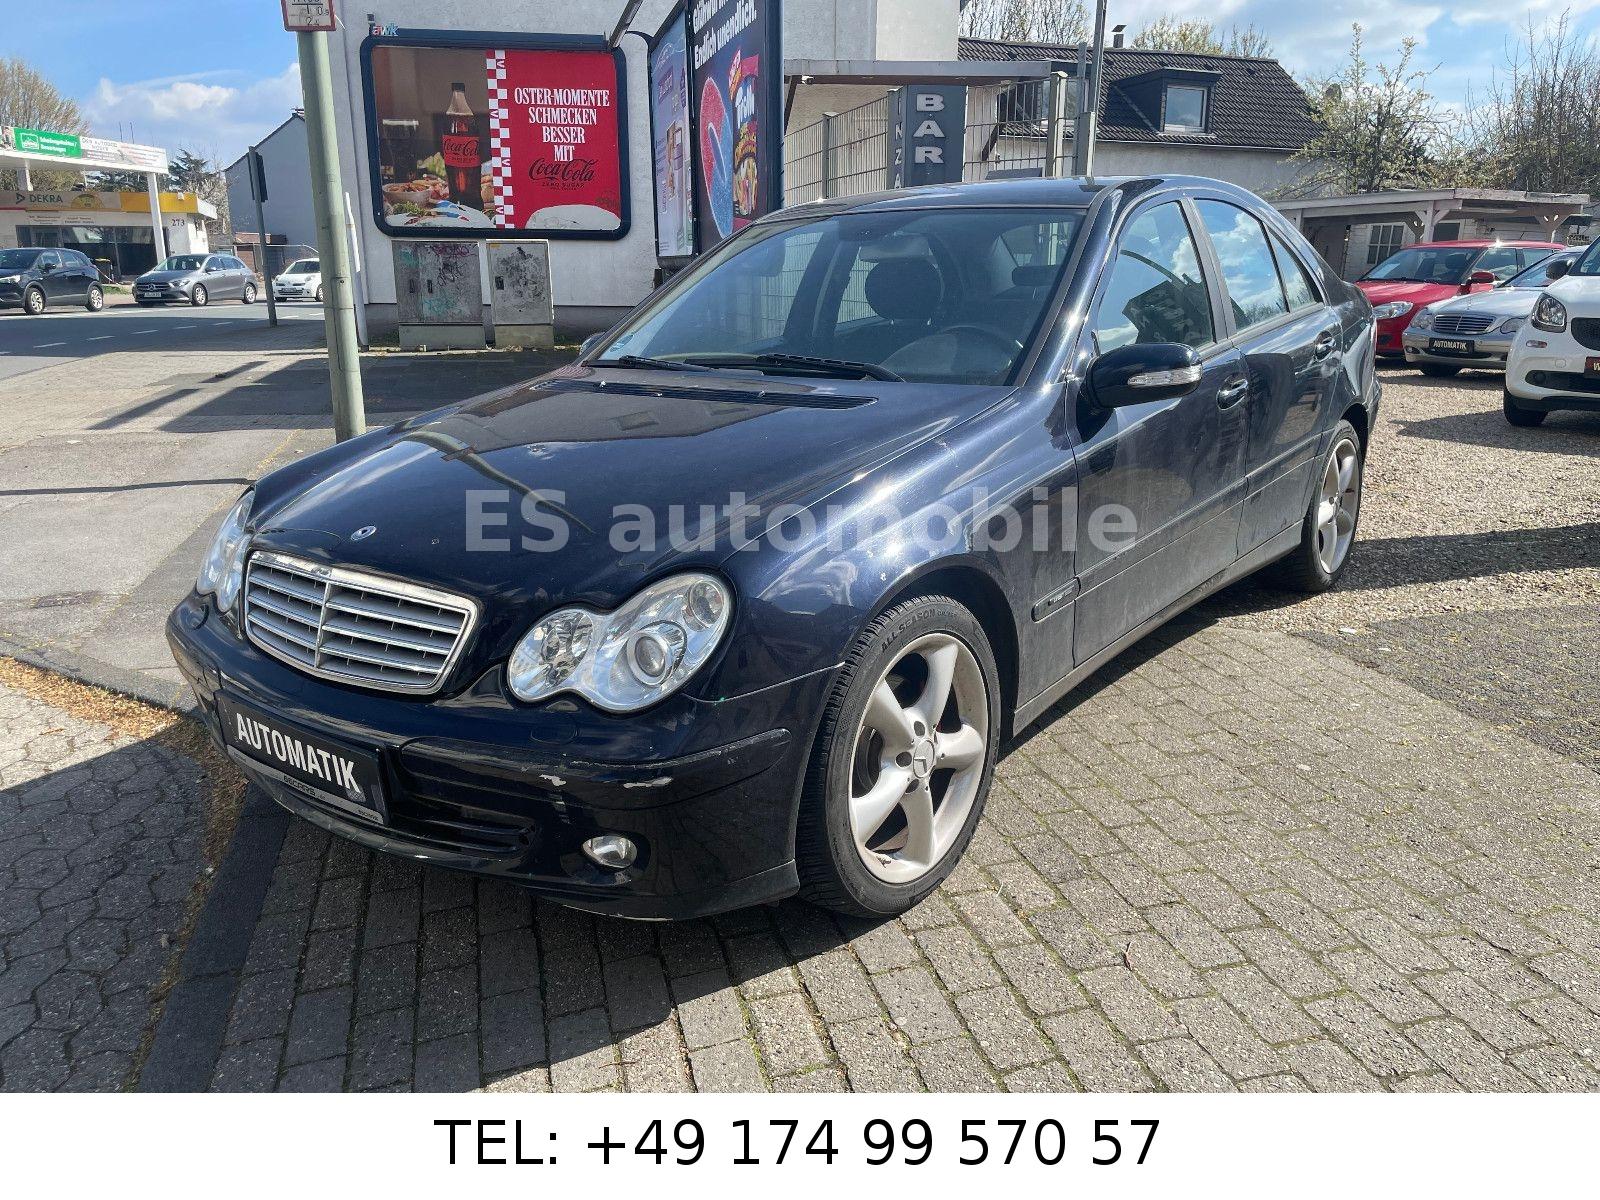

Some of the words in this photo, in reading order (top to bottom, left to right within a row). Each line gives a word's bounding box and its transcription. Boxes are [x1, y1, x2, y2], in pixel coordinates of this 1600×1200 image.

[694, 27, 717, 70] Endlich
[514, 87, 610, 107] OSTER-MOMENTE
[528, 106, 597, 125] SCHMECKEN
[542, 126, 585, 144] BESSER
[913, 93, 946, 164] BAR
[553, 144, 576, 162] MIT
[29, 194, 63, 204] DEKRA
[172, 219, 185, 227] 273
[1433, 340, 1467, 350] AUTOMATIK
[236, 712, 361, 794] AUTOMATIK
